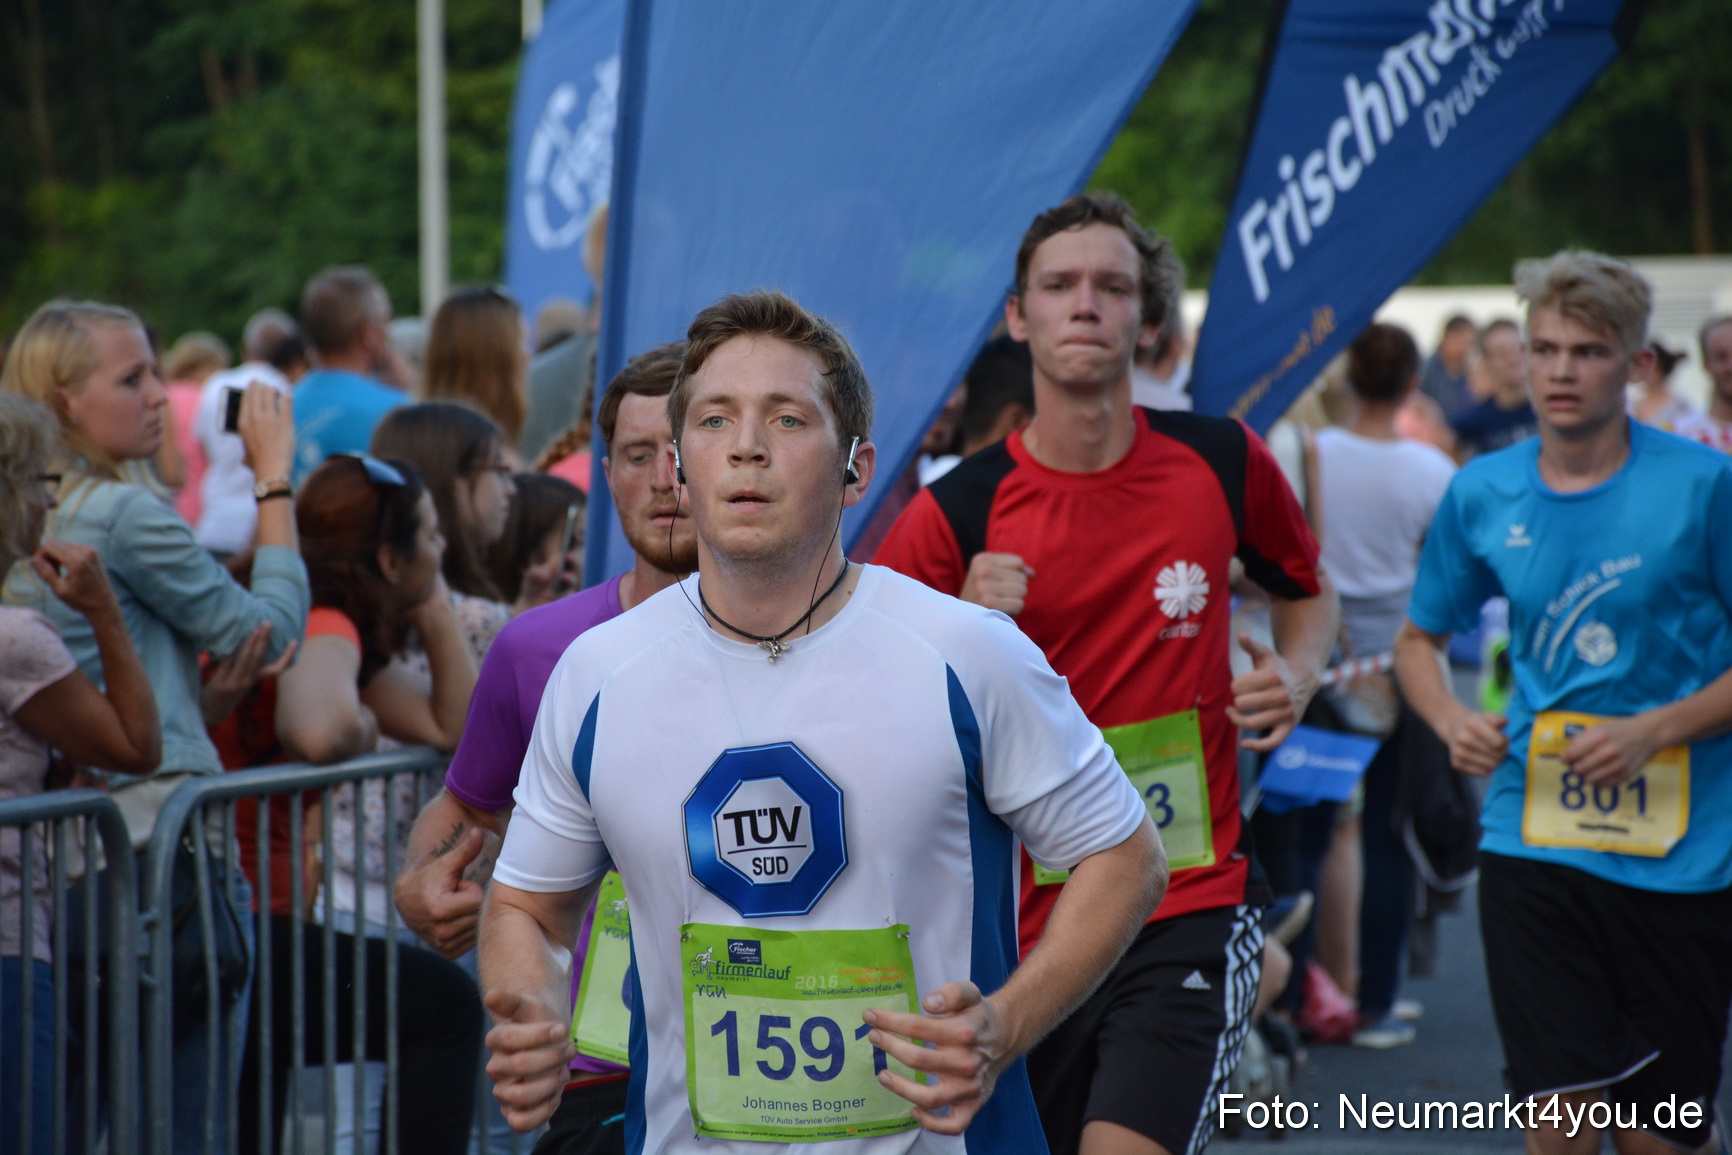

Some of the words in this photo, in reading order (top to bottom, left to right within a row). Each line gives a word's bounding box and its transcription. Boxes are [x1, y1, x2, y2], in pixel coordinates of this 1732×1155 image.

[1424, 43, 1502, 148] Druck
[1601, 553, 1642, 579] Bau
[1560, 770, 1647, 817] 801
[723, 806, 802, 847] TÜV
[752, 856, 789, 876] SÜD
[715, 961, 792, 980] firmenlauf
[716, 975, 750, 983] neumarkt
[795, 975, 838, 990] 2016
[710, 1010, 888, 1082] 1591
[742, 1096, 808, 1112] Johannes
[812, 1097, 866, 1112] Bogner
[760, 1115, 775, 1123] TÜV
[795, 1117, 822, 1125] Service
[824, 1115, 848, 1123] GmbH
